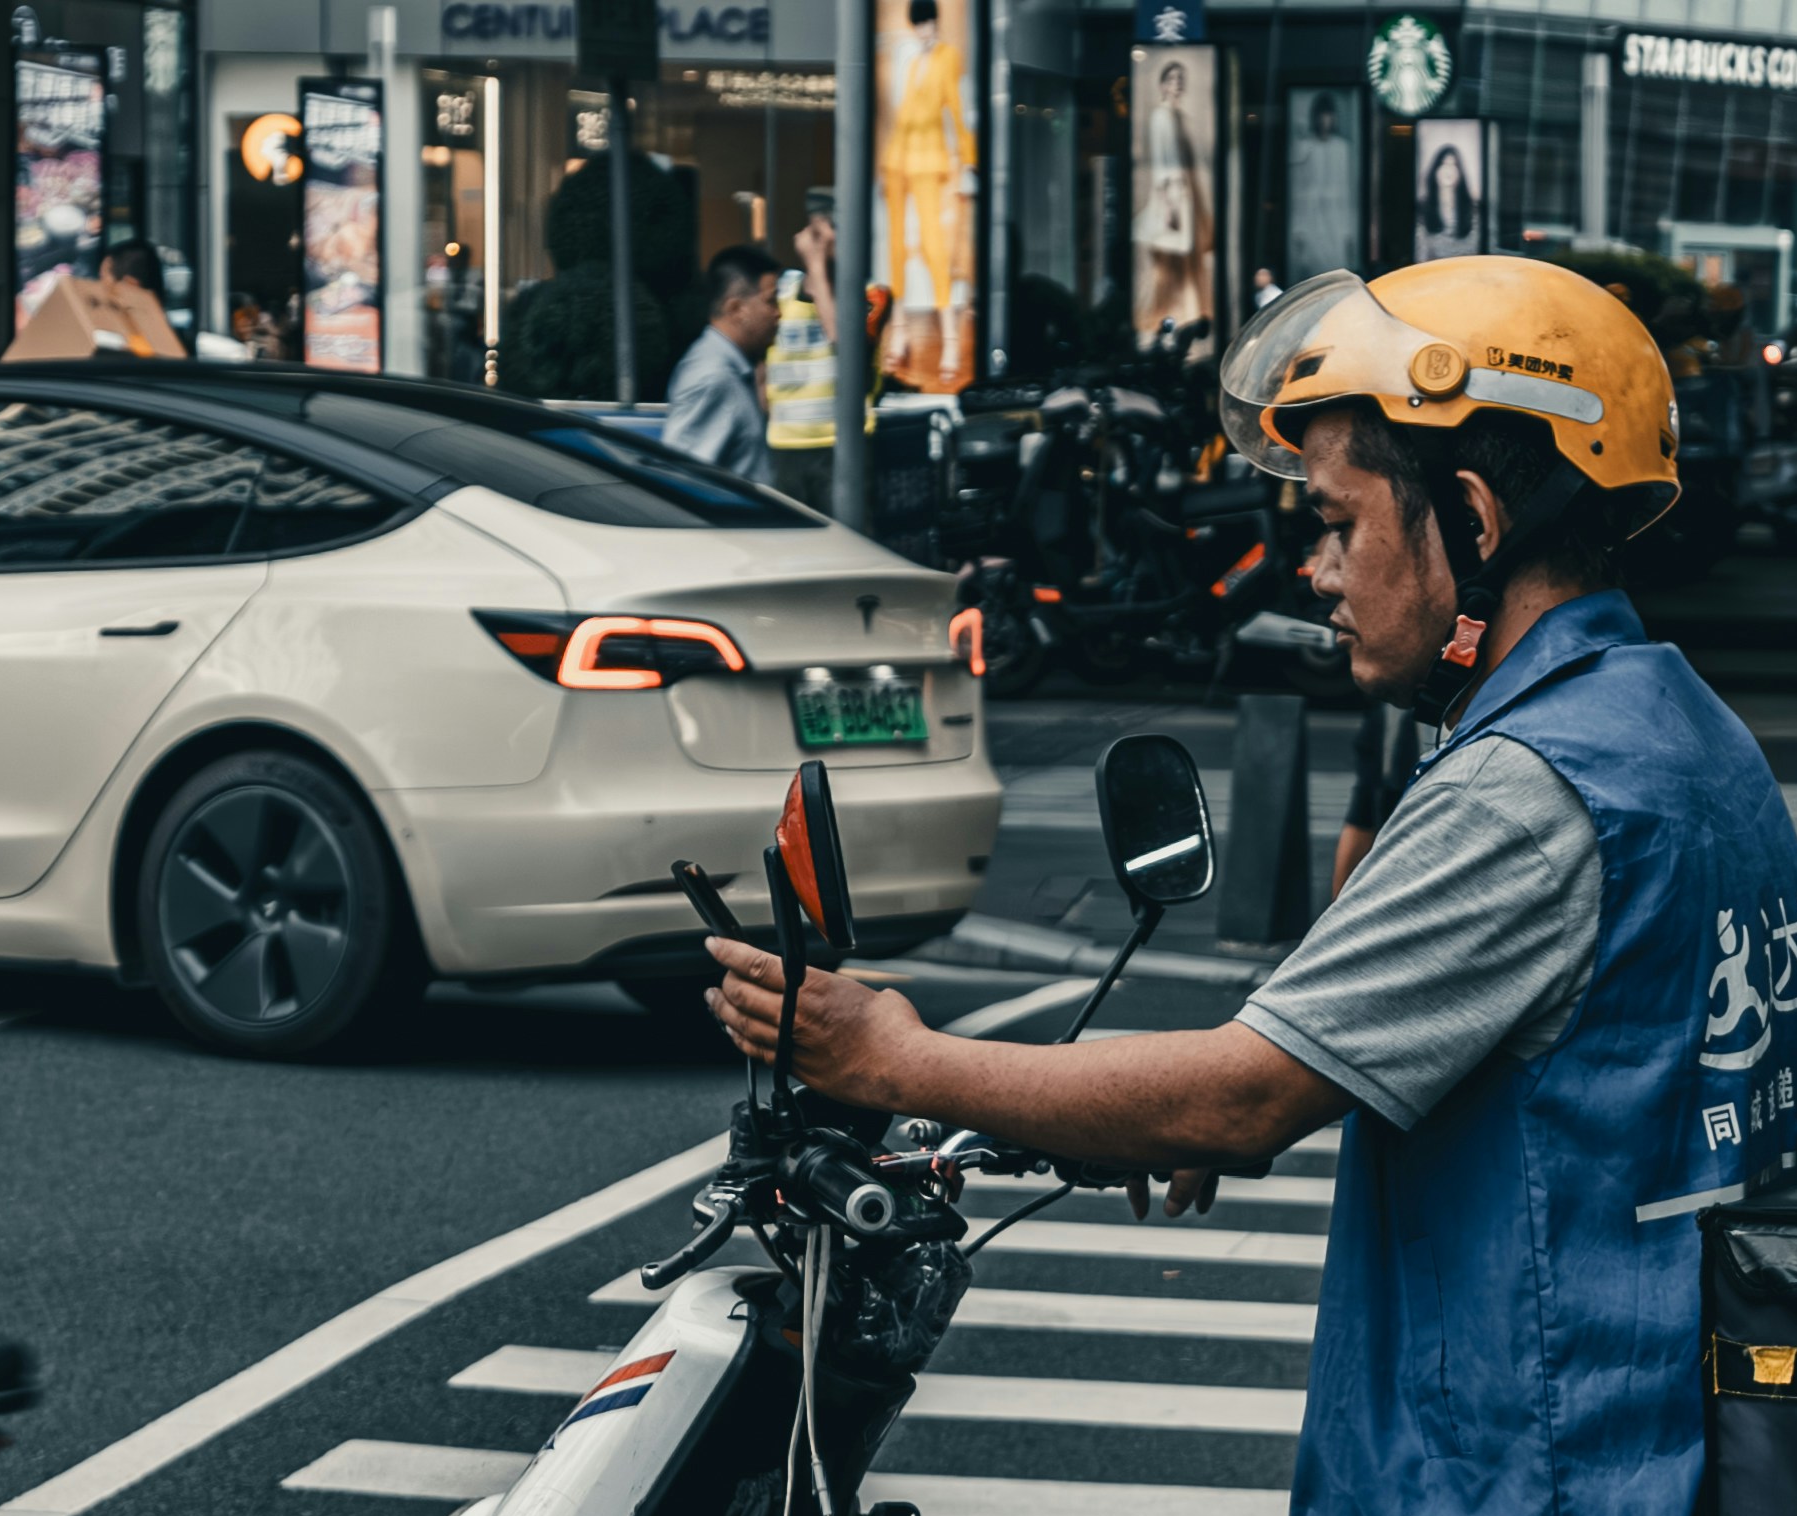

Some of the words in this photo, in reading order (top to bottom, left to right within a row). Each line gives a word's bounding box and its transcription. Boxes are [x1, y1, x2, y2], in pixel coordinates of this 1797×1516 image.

[441, 4, 575, 41] CENTU
[656, 6, 770, 44] LACE
[1623, 33, 1766, 88] STARBUCKS
[1507, 352, 1574, 382] 美团外卖
